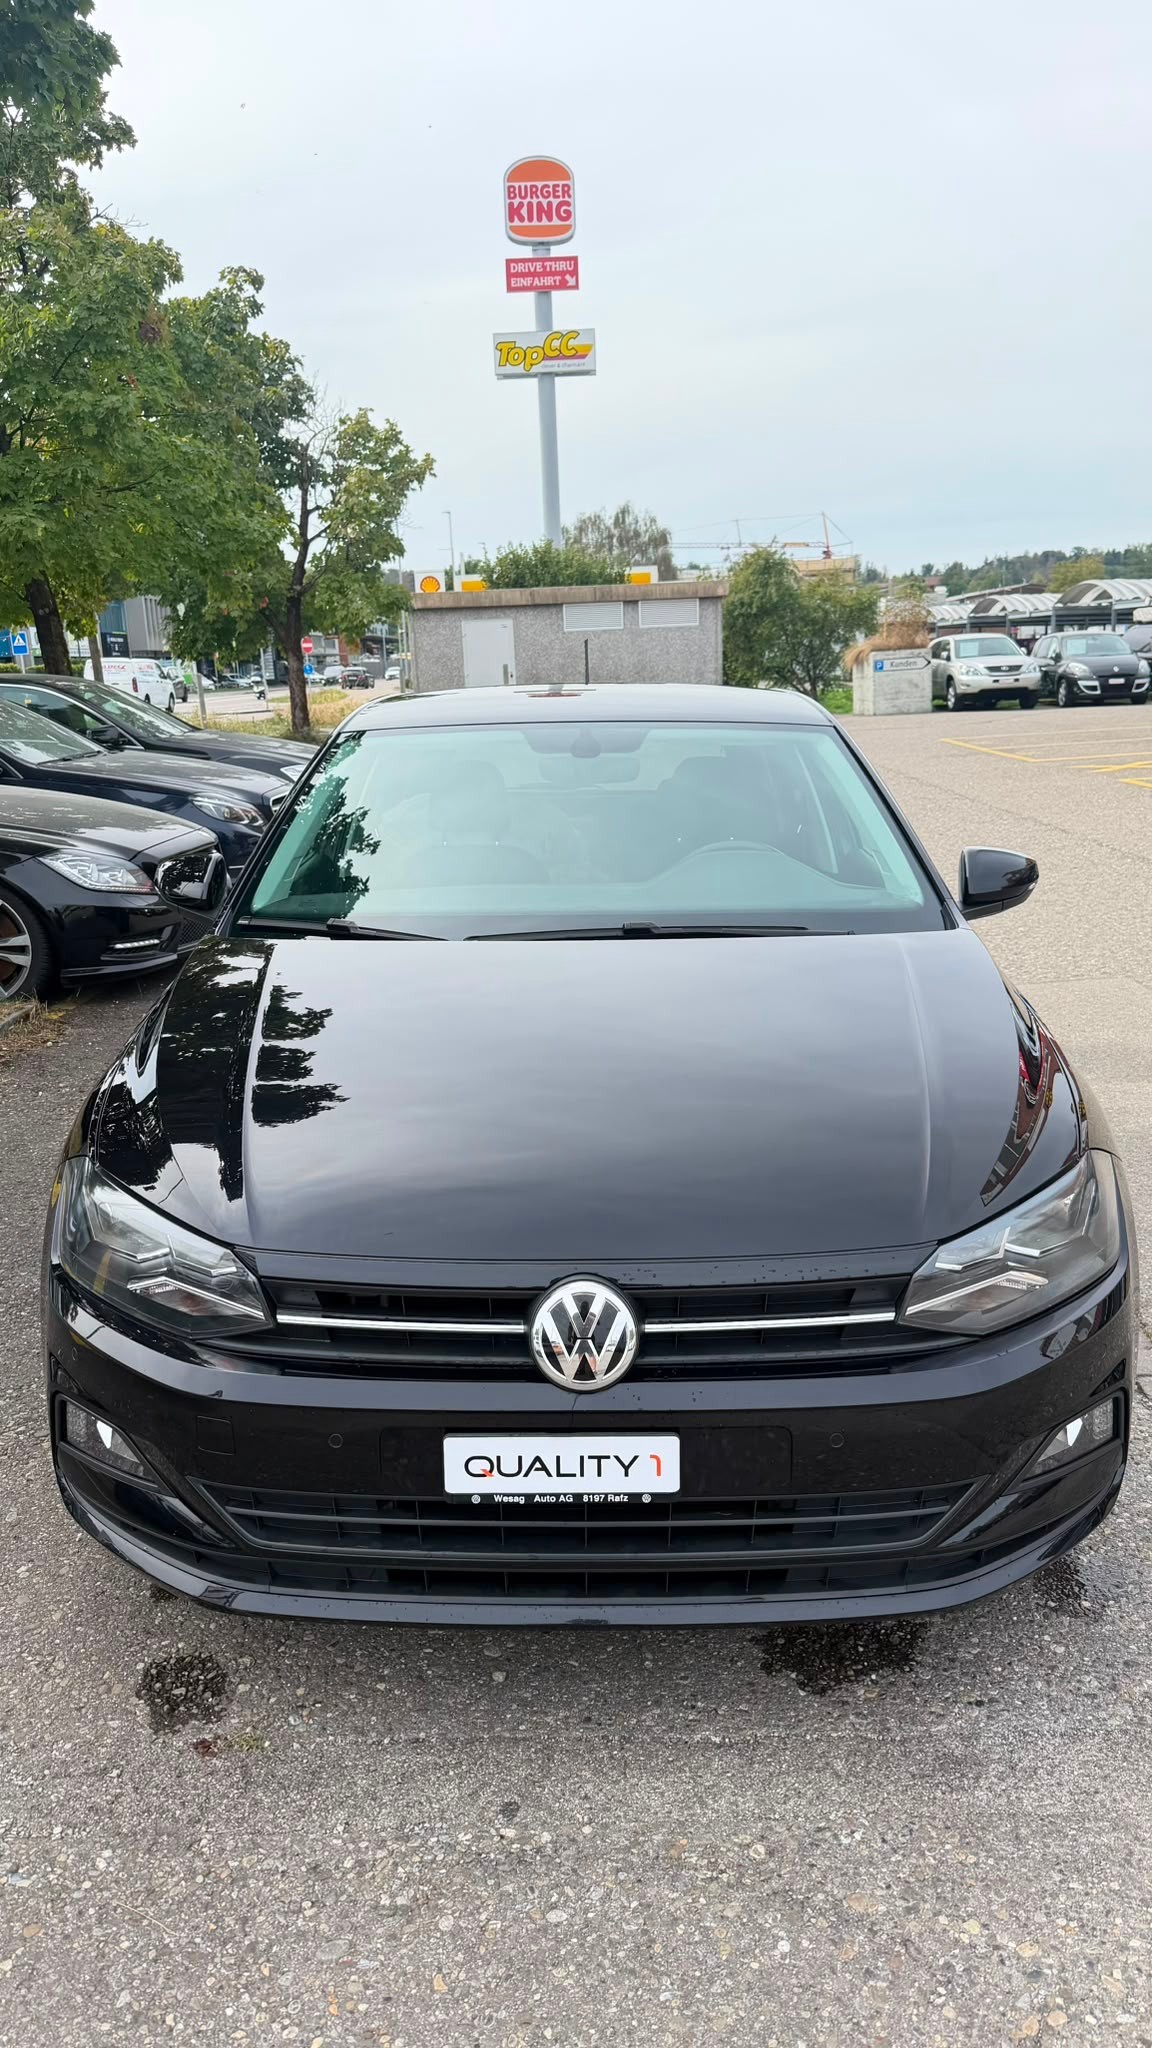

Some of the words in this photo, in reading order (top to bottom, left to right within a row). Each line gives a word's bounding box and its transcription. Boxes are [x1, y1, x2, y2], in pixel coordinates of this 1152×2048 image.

[507, 184, 572, 200] BURGER
[508, 200, 573, 223] KING
[510, 262, 543, 273] DRIVE
[544, 260, 574, 272] THRU
[511, 276, 562, 287] EINFAHRT
[496, 331, 580, 371] TopCC
[464, 1455, 639, 1478] QUALITY
[494, 1494, 525, 1504] Wesag
[534, 1494, 556, 1503] Auto
[558, 1494, 574, 1503] AG
[583, 1494, 605, 1502] 8197
[607, 1493, 629, 1502] Rafz
